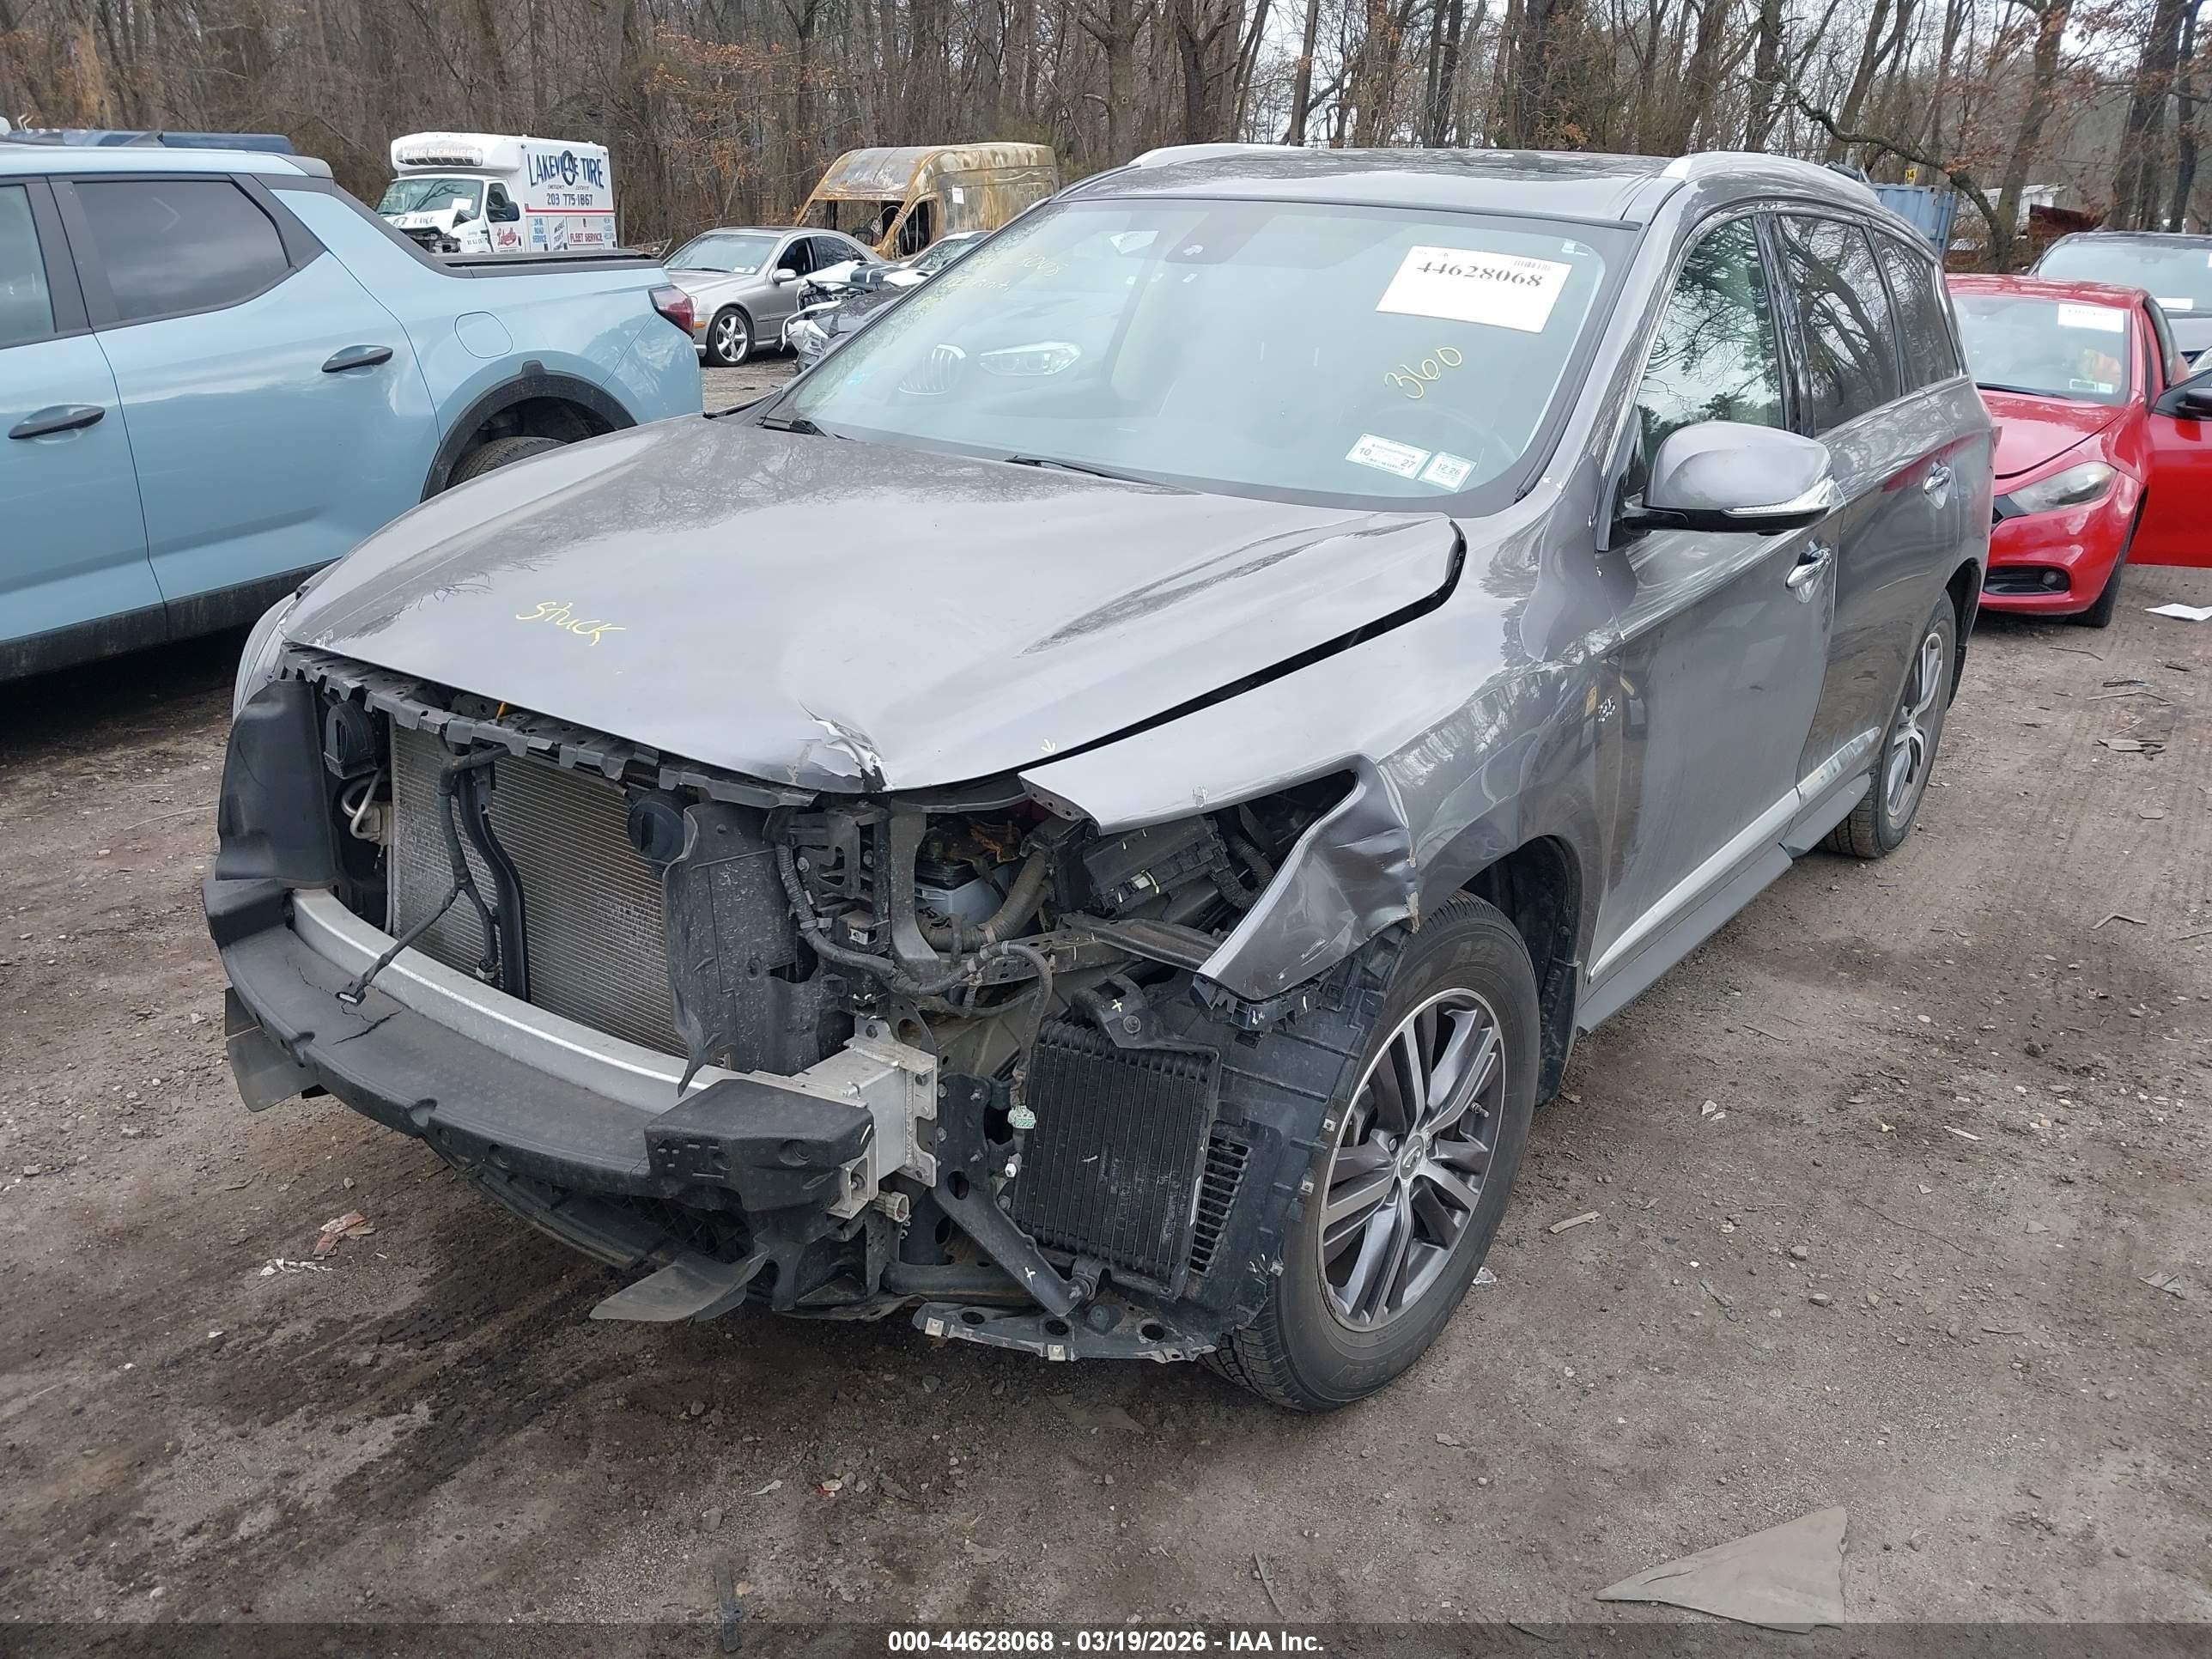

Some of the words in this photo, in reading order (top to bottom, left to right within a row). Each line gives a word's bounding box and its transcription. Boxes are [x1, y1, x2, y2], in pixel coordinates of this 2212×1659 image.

[580, 157, 605, 190] TIRE
[546, 192, 560, 205] 203
[1416, 261, 1544, 288] 44628068
[1384, 346, 1463, 400] 360
[1359, 447, 1372, 457] 10
[1401, 459, 1417, 469] 27
